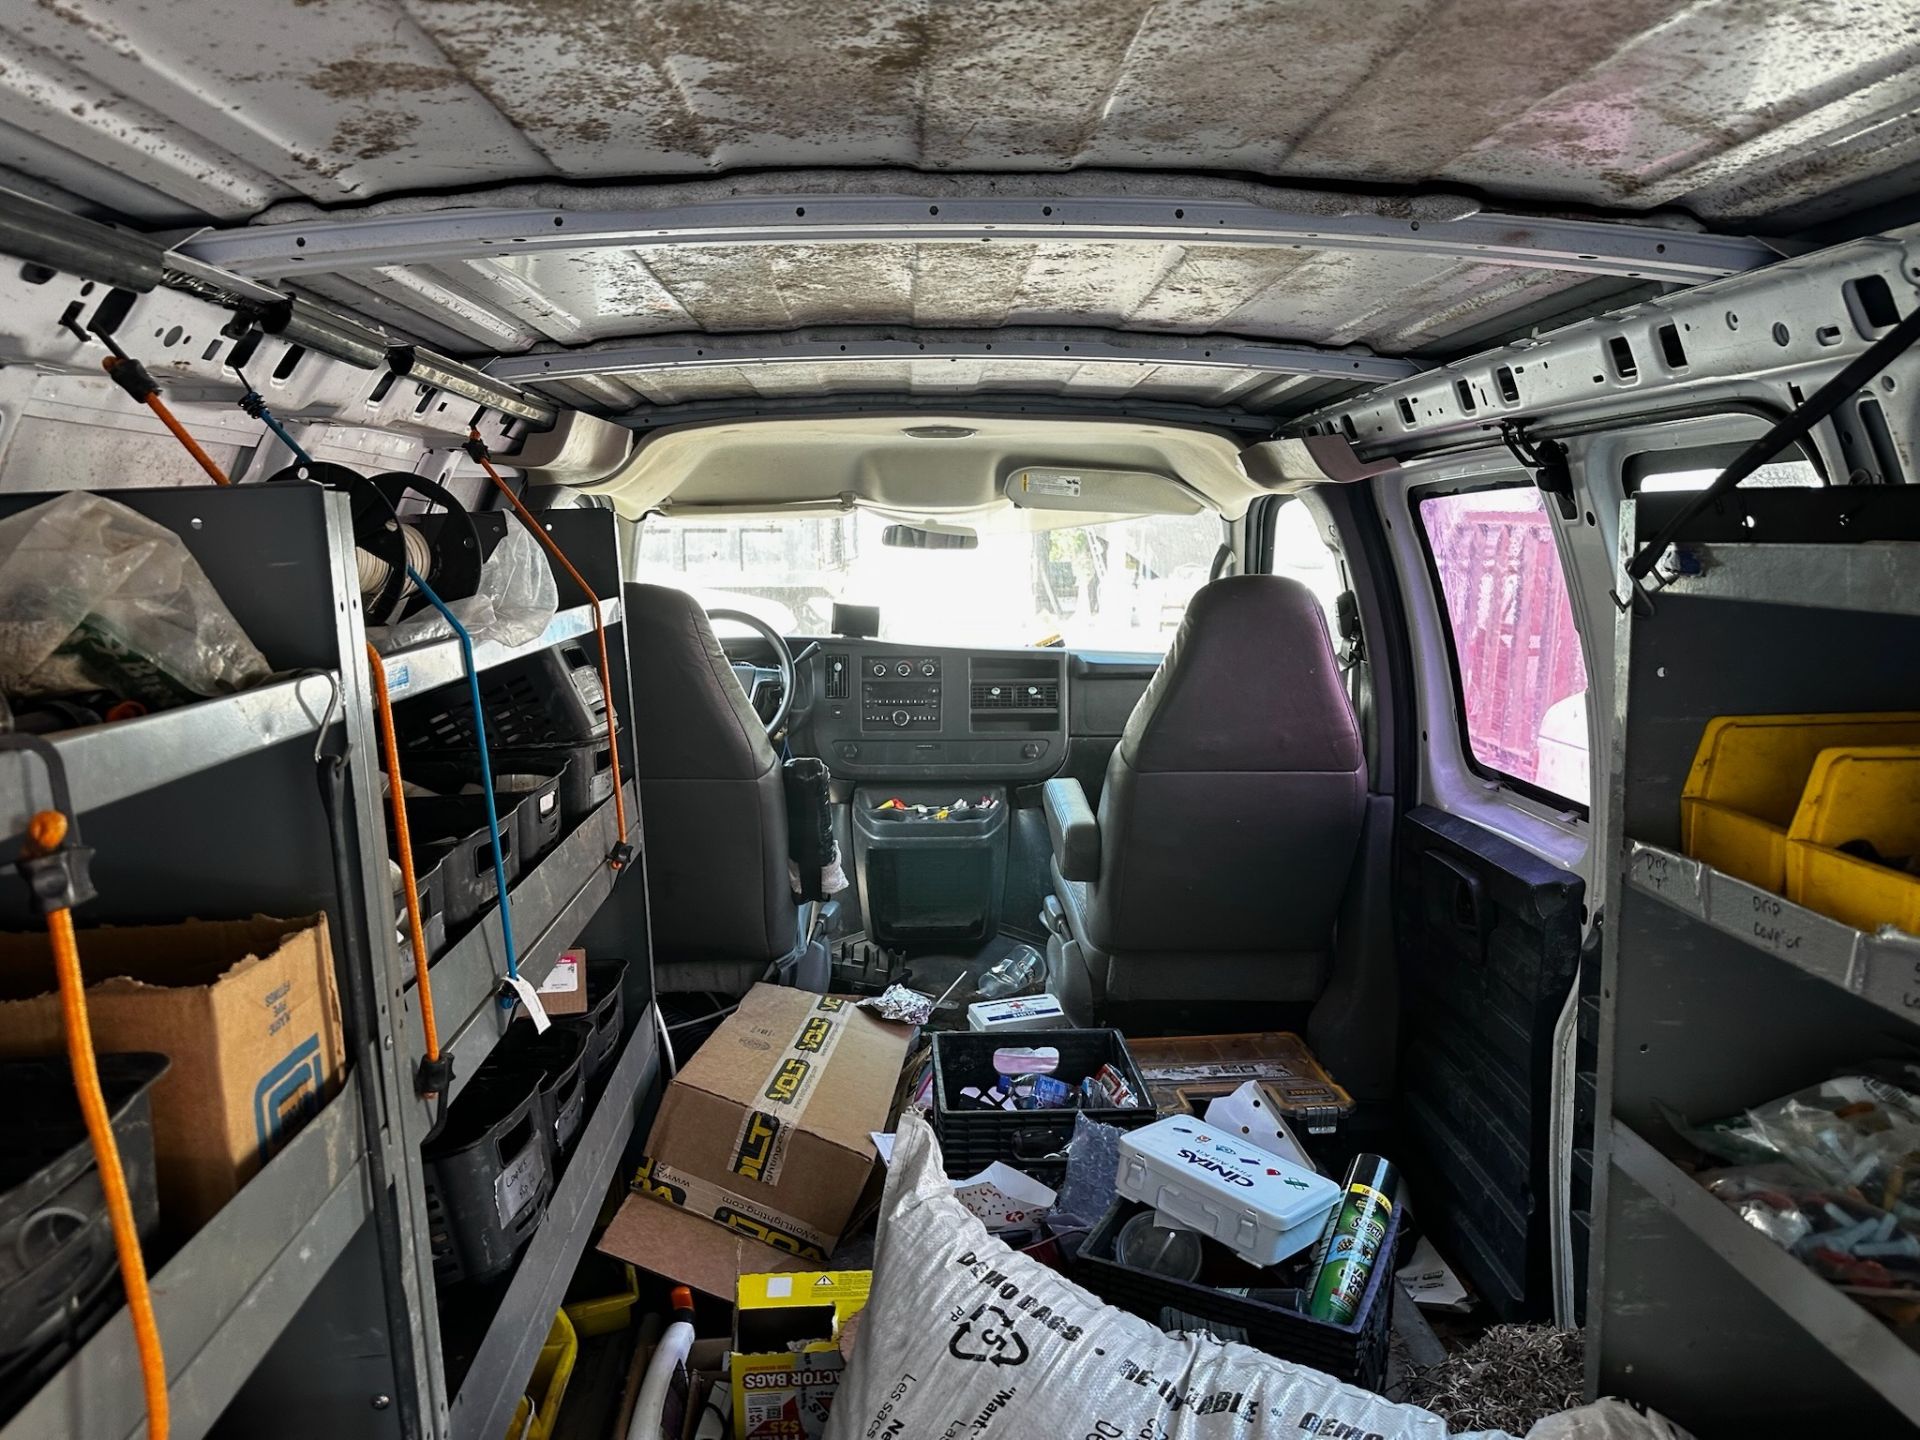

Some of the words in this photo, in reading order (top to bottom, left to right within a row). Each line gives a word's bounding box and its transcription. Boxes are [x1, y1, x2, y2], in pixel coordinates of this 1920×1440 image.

[798, 1017, 831, 1051] VOLT
[767, 1059, 807, 1101] VOLT
[957, 1251, 1020, 1300] DEMO
[1016, 1294, 1084, 1343] BAGS
[950, 1305, 966, 1323] PP
[980, 1328, 1008, 1352] 5
[745, 1373, 788, 1389] BAGS
[890, 1373, 917, 1402] Les
[866, 1401, 895, 1440] sacs
